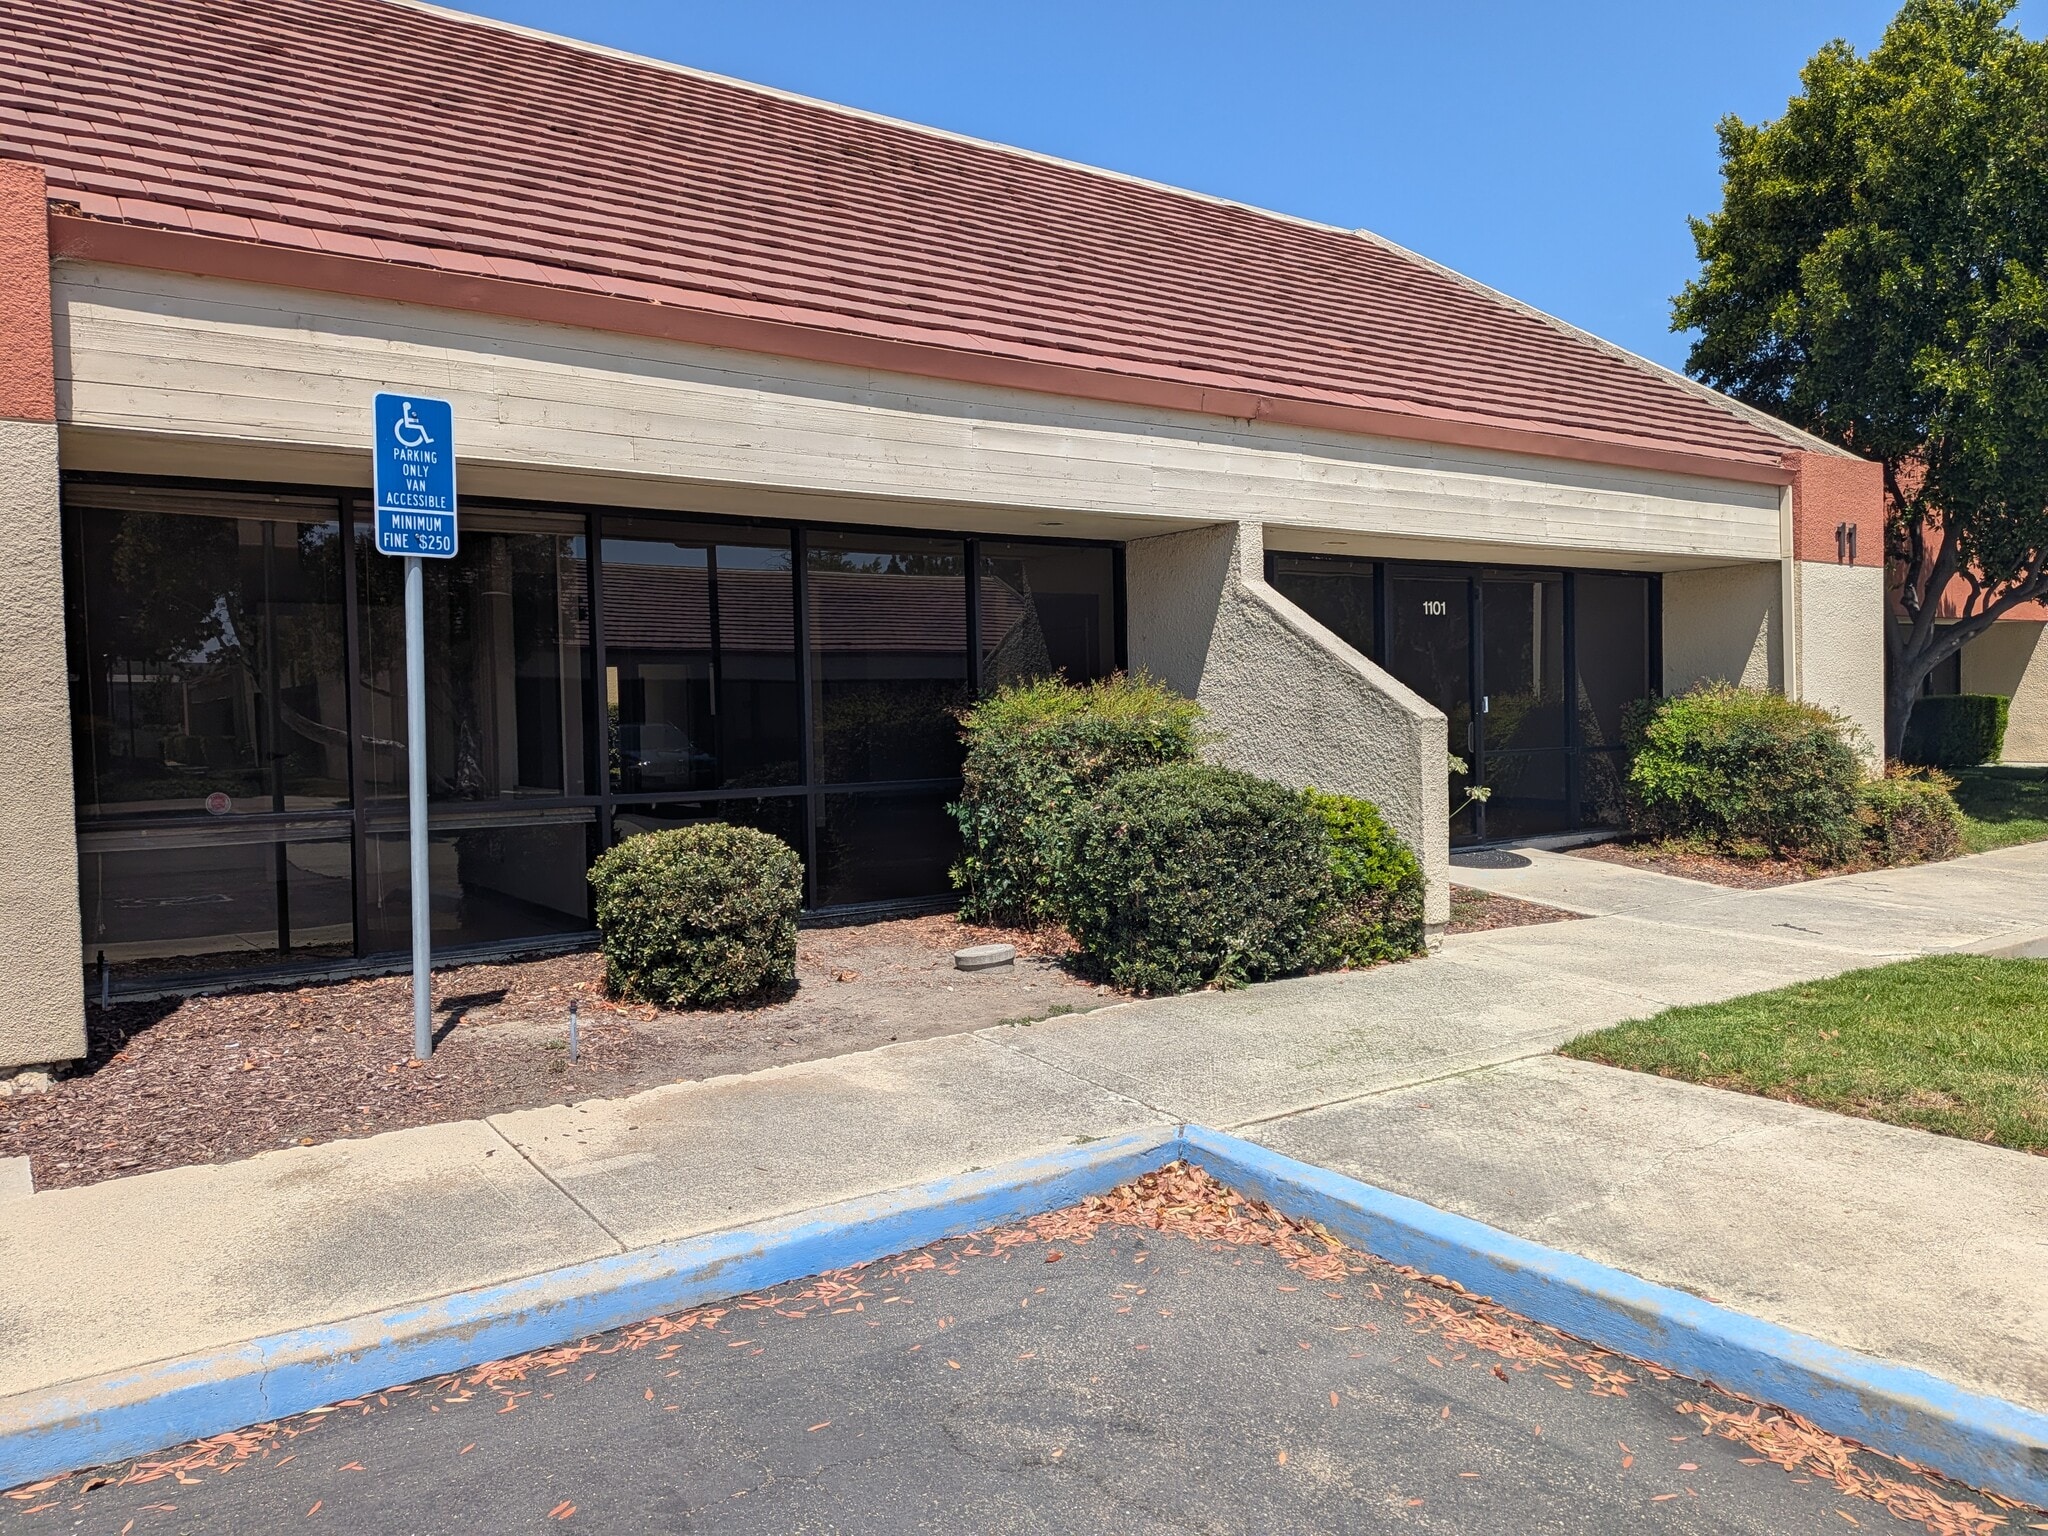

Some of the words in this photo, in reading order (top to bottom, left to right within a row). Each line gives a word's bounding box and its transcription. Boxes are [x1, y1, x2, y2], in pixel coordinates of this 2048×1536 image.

[393, 448, 437, 464] PARKING
[402, 464, 429, 478] ONLY
[406, 479, 426, 492] VAN
[386, 492, 446, 508] ACCESSIBLE
[392, 515, 442, 532] MINIMUM
[384, 532, 409, 548] FINE
[418, 534, 450, 551] $250
[1422, 601, 1446, 615] 1101
